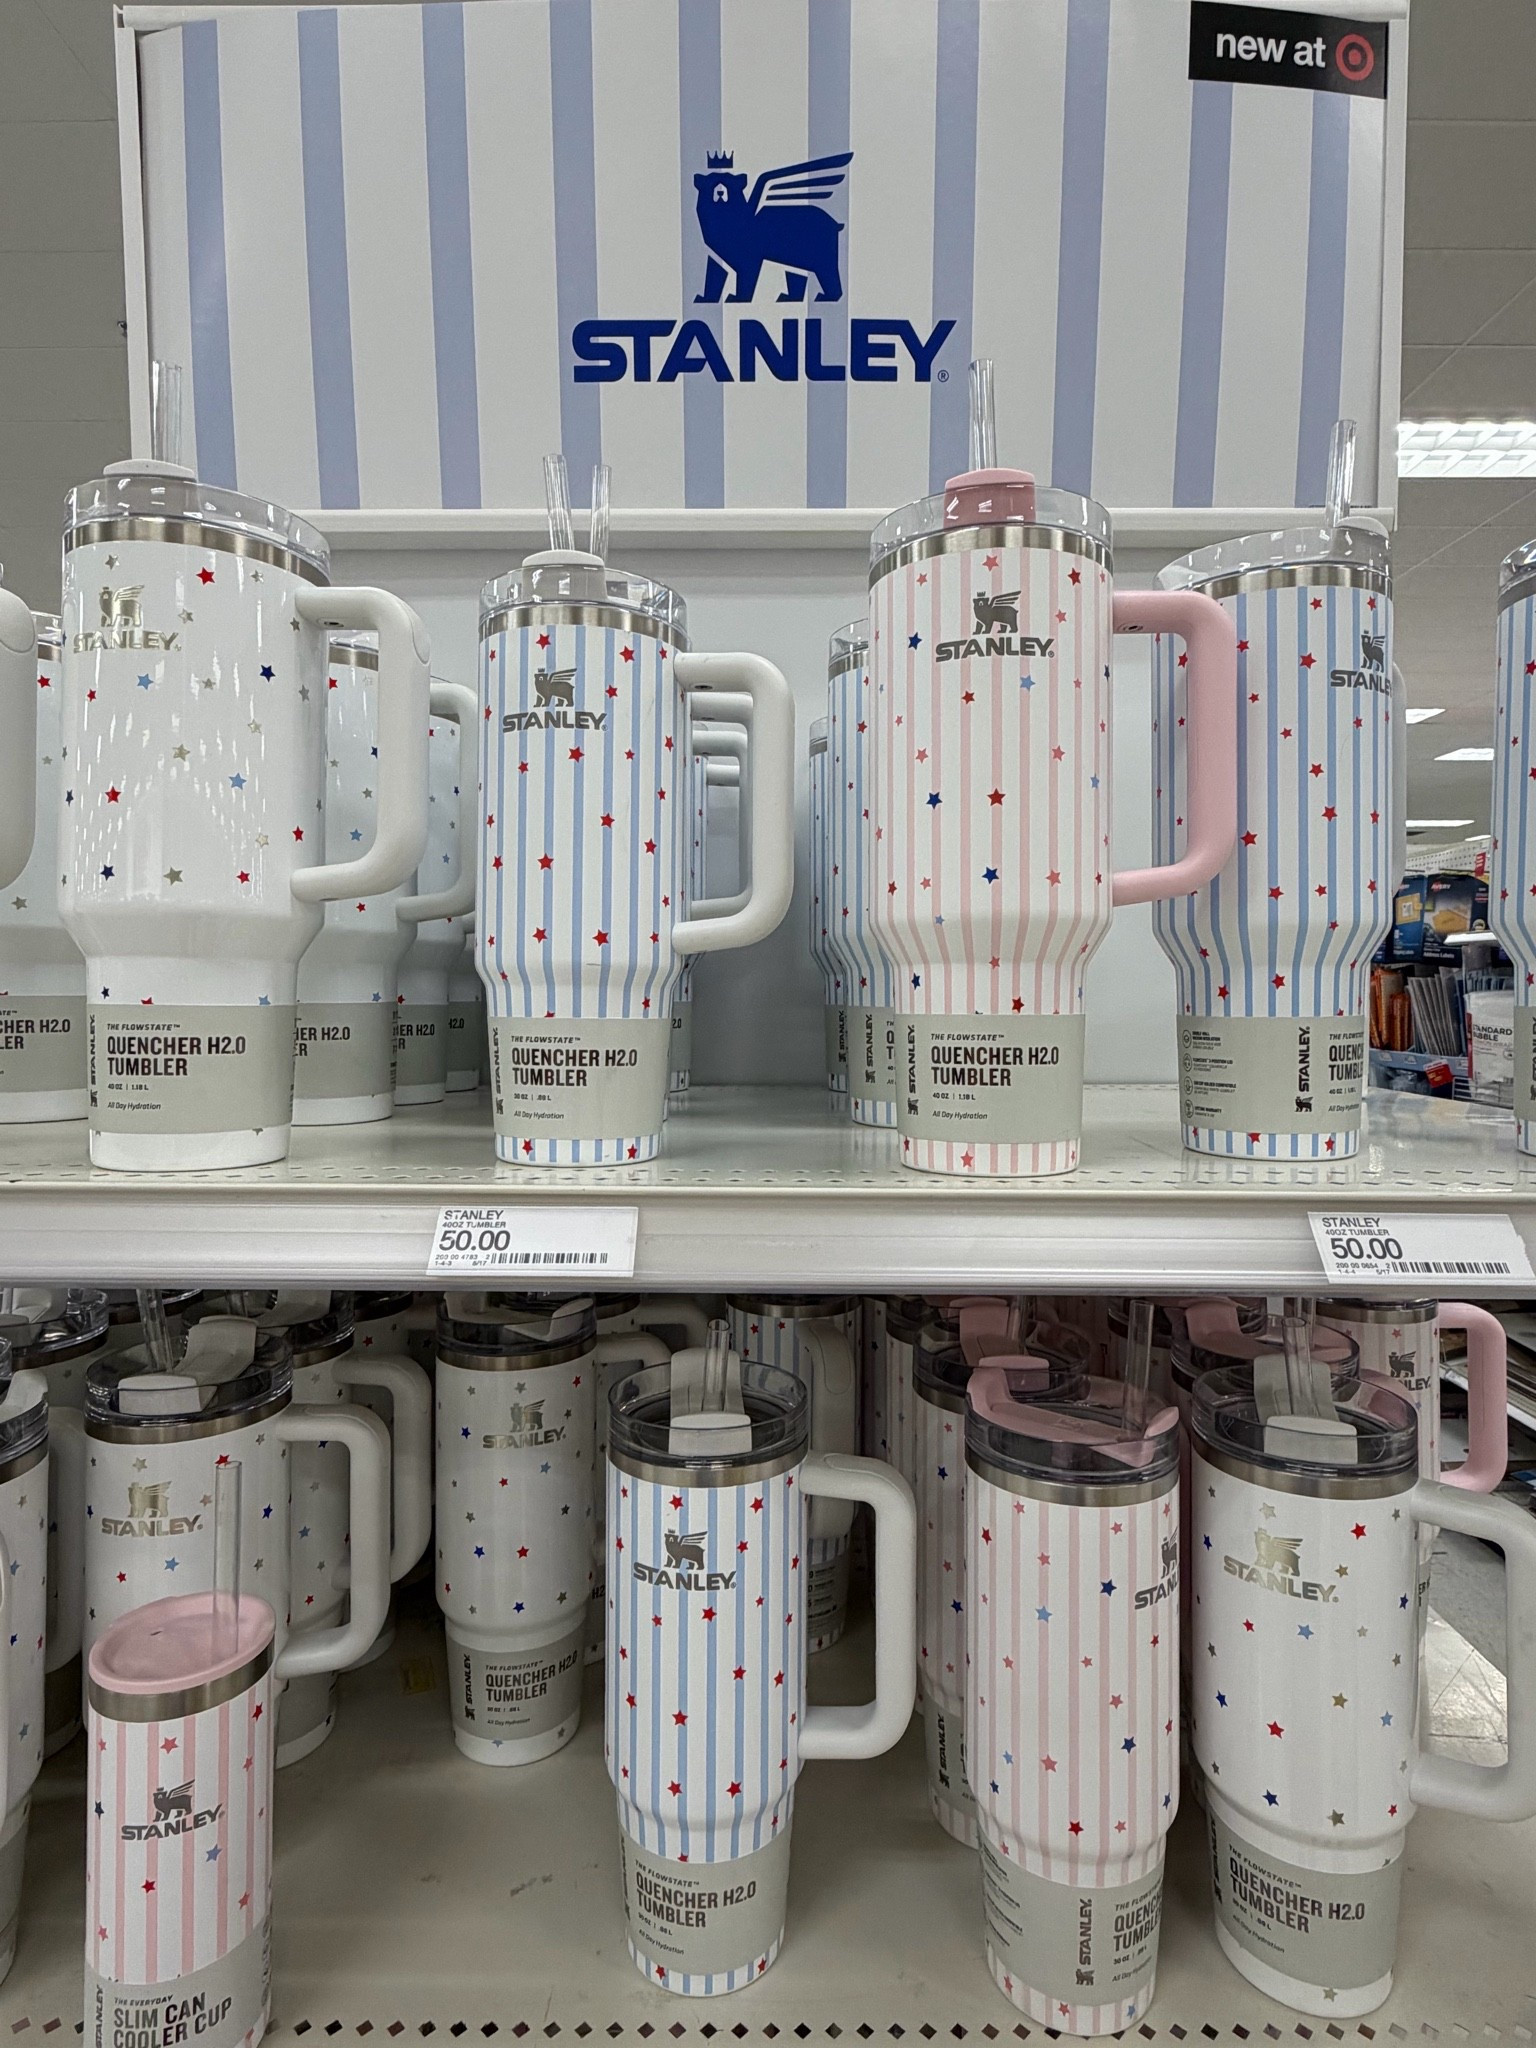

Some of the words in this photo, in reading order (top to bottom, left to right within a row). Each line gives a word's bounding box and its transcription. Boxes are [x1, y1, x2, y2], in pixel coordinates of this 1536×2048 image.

[1216, 33, 1287, 63] new
[1293, 37, 1326, 68] at
[40, 1019, 71, 1033] H2.0
[107, 1023, 120, 1031] THE
[321, 1026, 351, 1041] H2.0
[107, 1036, 202, 1056] QUENCHER
[207, 1035, 246, 1055] H2.0
[511, 1035, 524, 1043] THE
[931, 1033, 944, 1041] THE
[512, 1048, 600, 1067] QUENCHER
[605, 1048, 638, 1067] H2.0
[931, 1046, 1023, 1065] QUENCHER
[1028, 1046, 1059, 1065] H2.0
[107, 1057, 188, 1076] TUMBLER
[513, 1067, 587, 1087] TUMBLER
[931, 1067, 1011, 1087] TUMBLER
[127, 1102, 161, 1111] Hydration
[533, 1112, 564, 1120] Hydration
[954, 1112, 988, 1120] Hydration
[444, 1210, 504, 1220] STANLEY
[1321, 1217, 1381, 1228] STANLEY
[439, 1230, 511, 1251] 50.00
[1331, 1237, 1403, 1259] 50.00
[486, 1664, 556, 1688] QUENCHER
[486, 1682, 547, 1702] TUMBLER
[636, 1871, 718, 1910] QUENCHER
[723, 1880, 757, 1908] H2.0
[1229, 1857, 1323, 1918] QUENCHER
[1328, 1903, 1365, 1921] H2.0
[636, 1888, 706, 1928] TUMBLER
[1115, 1901, 1129, 1911] THE
[1230, 1874, 1310, 1934] TUMBLER
[129, 1994, 173, 2006] EVERYDAY
[114, 2007, 158, 2029] SLIM
[165, 1992, 206, 2024] CAN
[114, 2022, 188, 2048] COOLER
[194, 1997, 232, 2035] CUP
